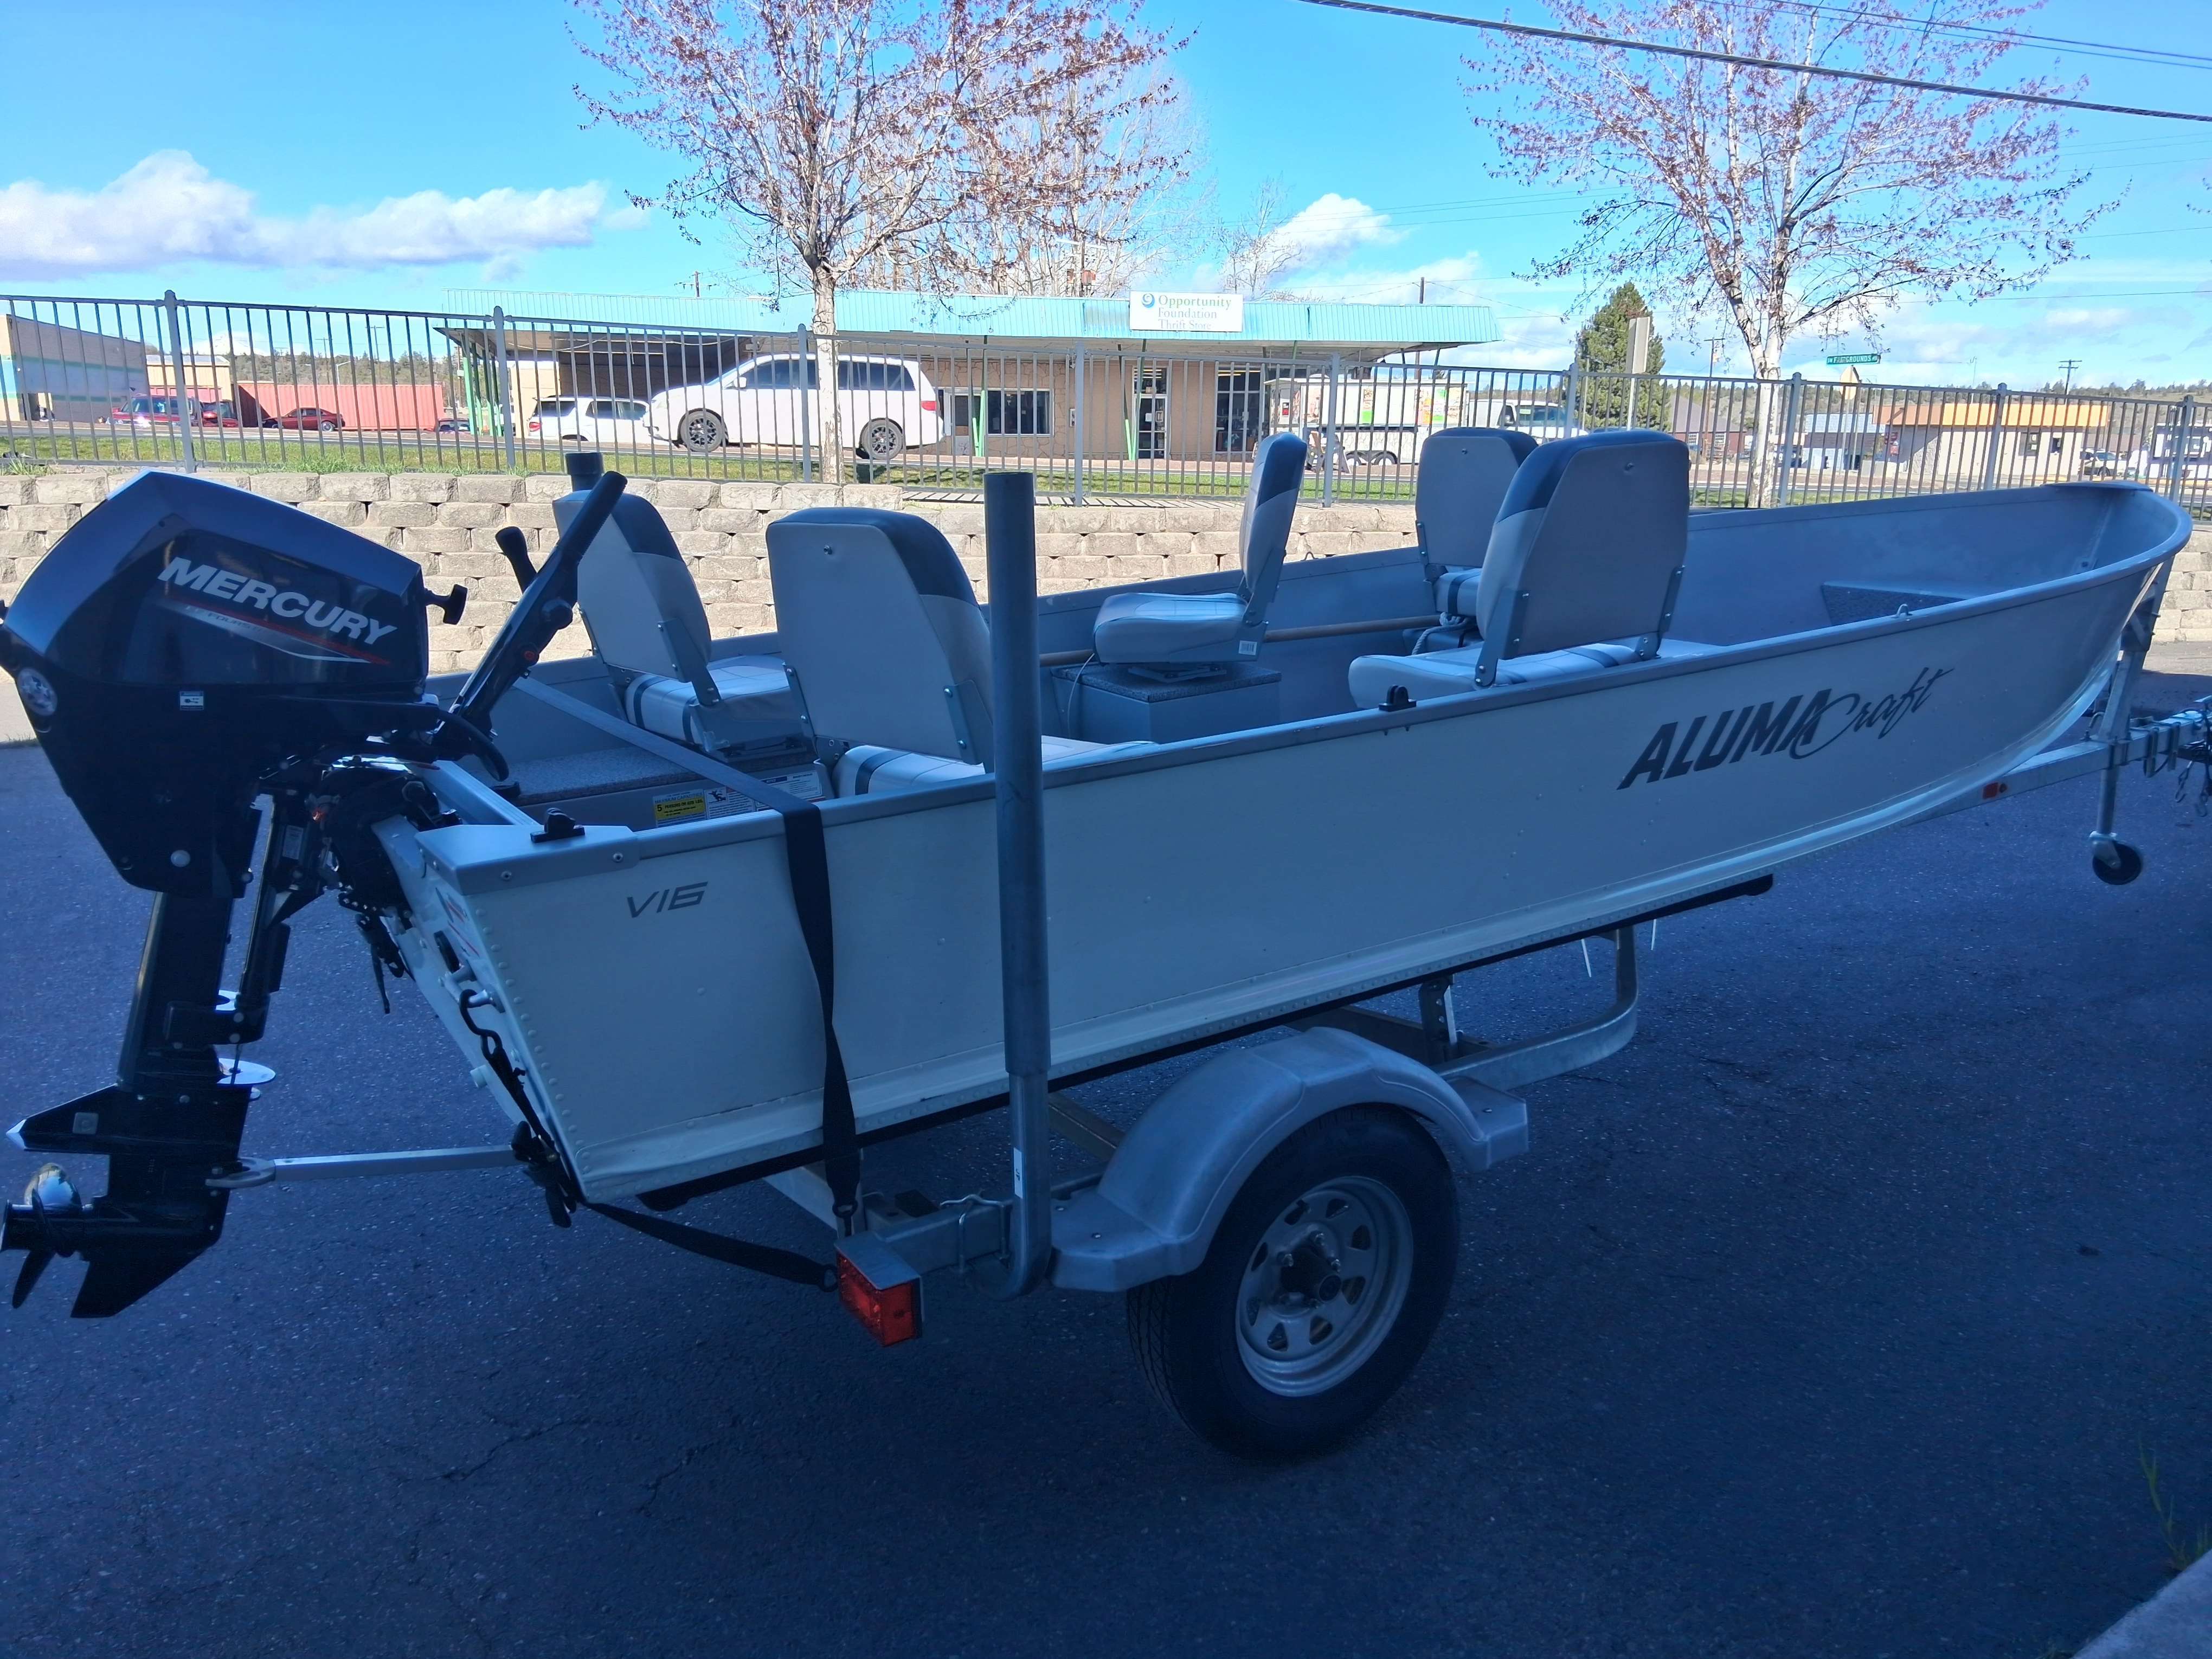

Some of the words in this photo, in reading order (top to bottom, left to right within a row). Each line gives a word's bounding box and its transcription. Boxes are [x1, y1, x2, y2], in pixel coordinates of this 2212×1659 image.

[1159, 295, 1231, 310] Opportunity
[1159, 308, 1217, 318] Foundation
[1159, 319, 1185, 329] Thrift
[1189, 320, 1212, 330] Store
[157, 556, 398, 645] MERCURY
[627, 881, 708, 918] V16
